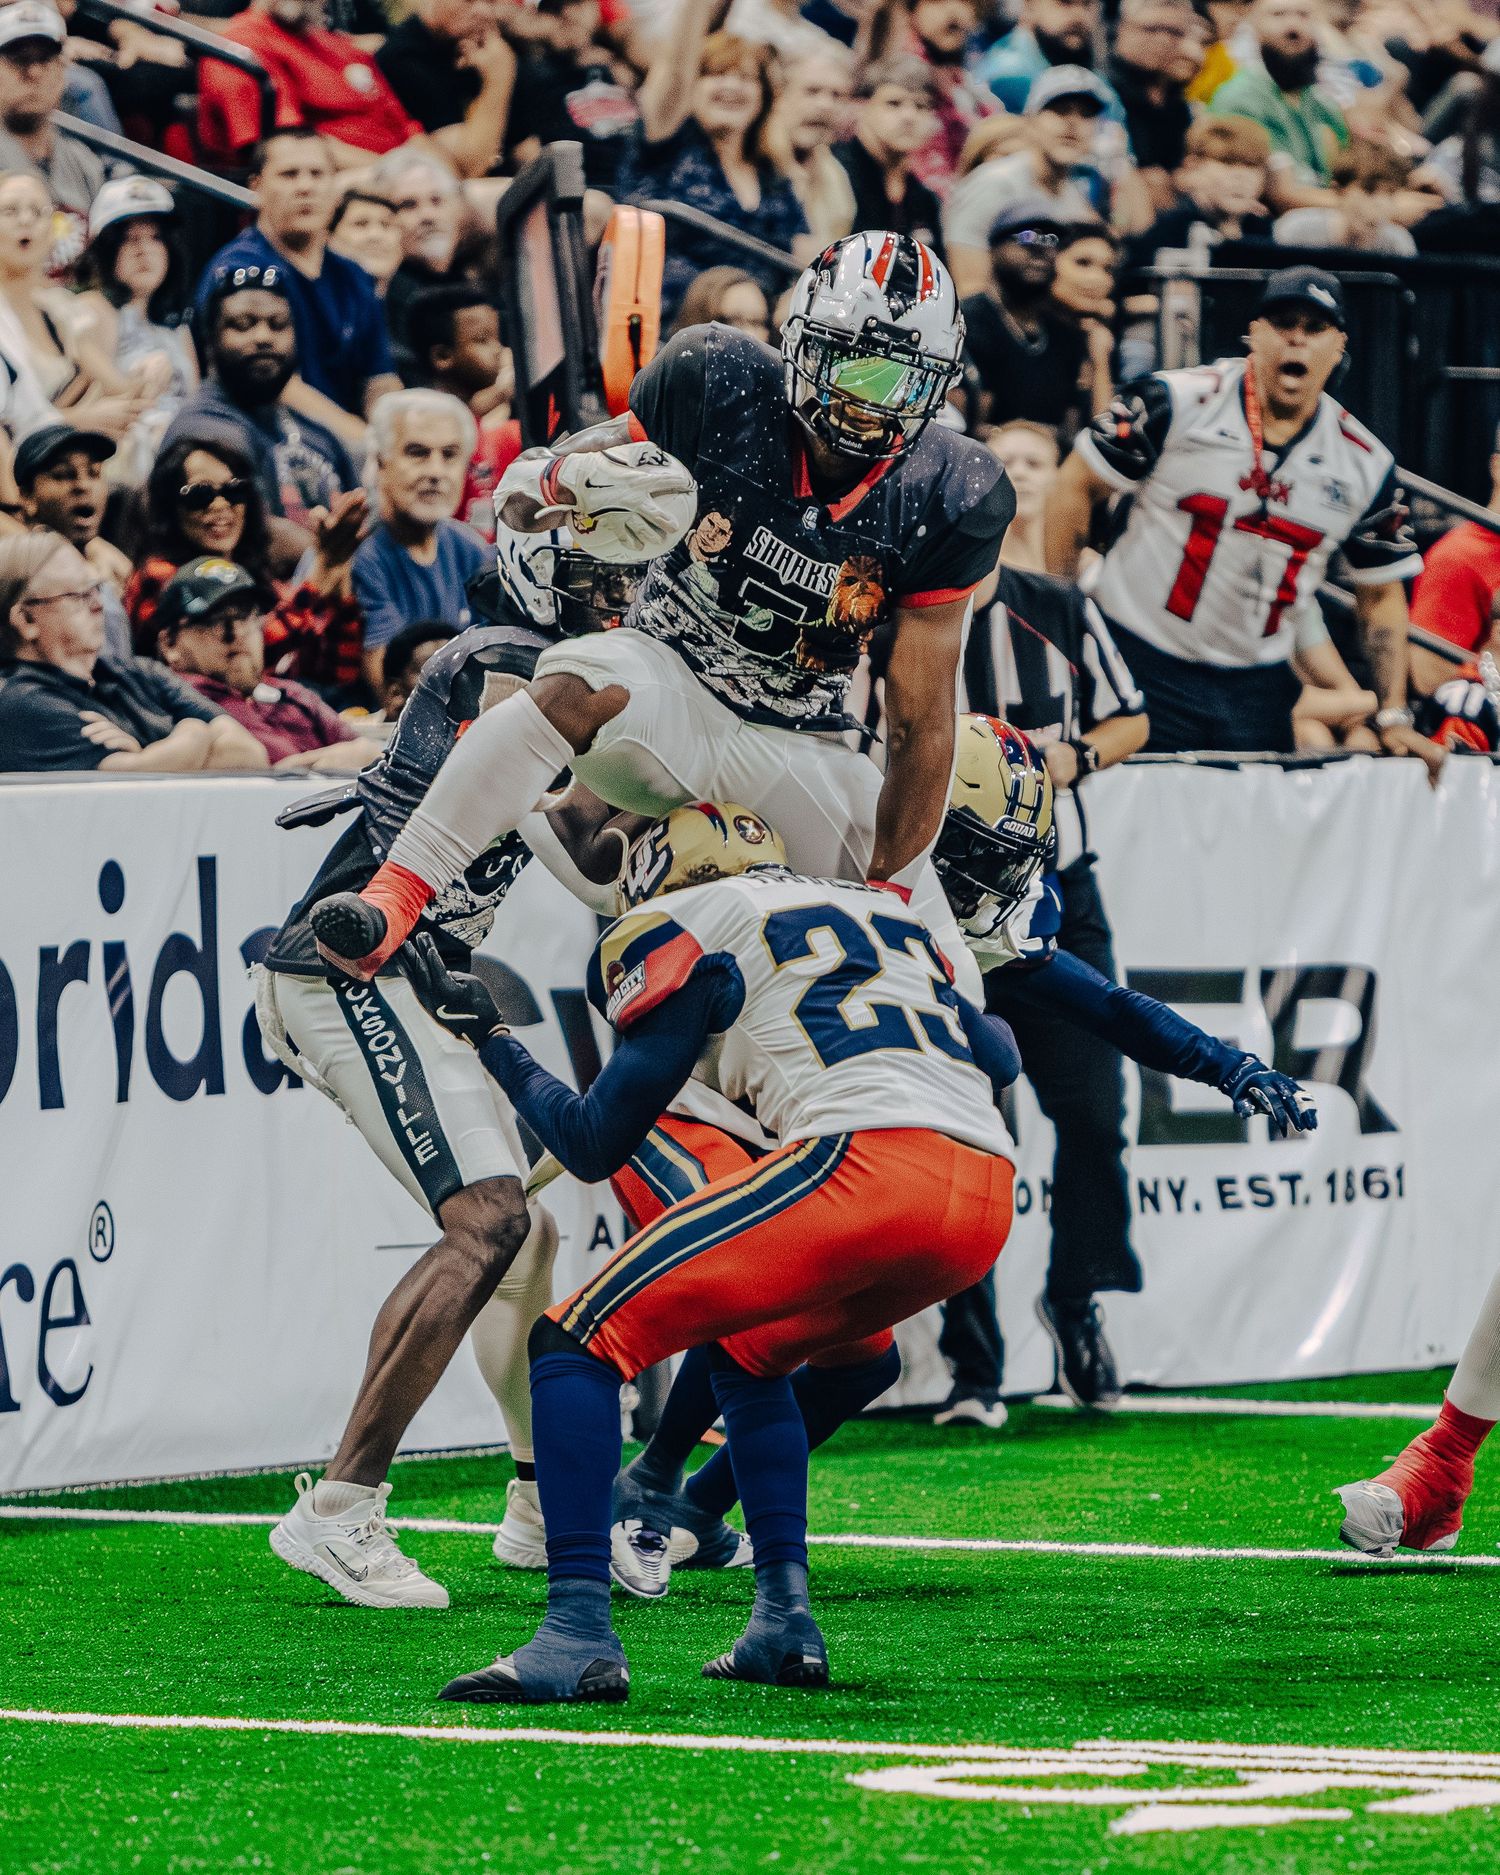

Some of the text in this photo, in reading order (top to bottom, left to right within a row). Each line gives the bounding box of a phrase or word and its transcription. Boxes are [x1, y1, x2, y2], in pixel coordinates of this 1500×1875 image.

[743, 525, 840, 598] SHARKS
[1164, 492, 1326, 638] 17
[758, 901, 978, 1071] 23
[341, 981, 439, 1167] CKSONVILLE
[1216, 1173, 1312, 1210] EST.
[1326, 1163, 1407, 1203] 1861
